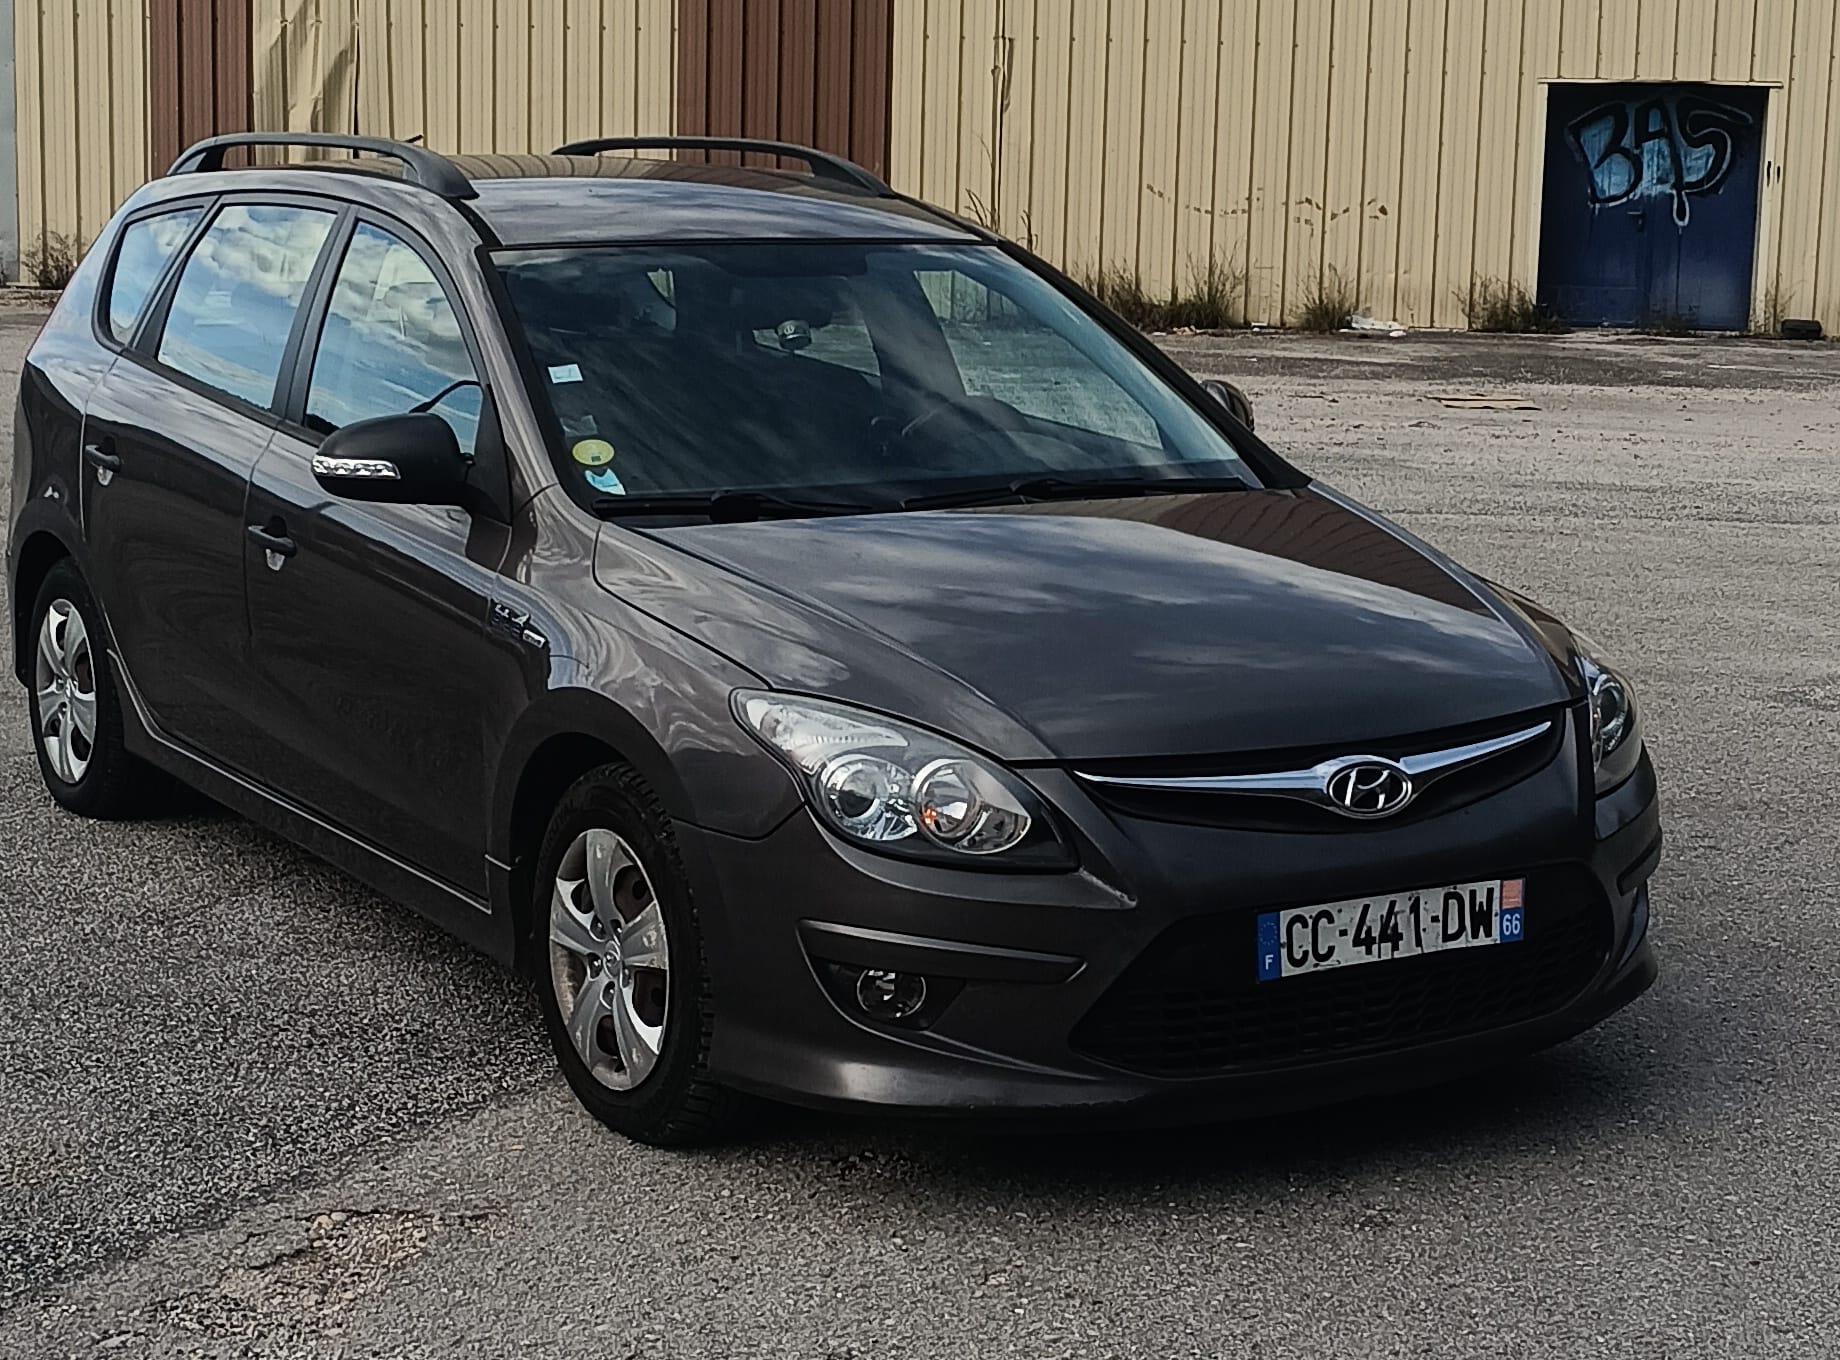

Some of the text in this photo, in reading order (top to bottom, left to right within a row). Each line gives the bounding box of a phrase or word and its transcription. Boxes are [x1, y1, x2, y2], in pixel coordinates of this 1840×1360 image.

[1265, 886, 1521, 970] F CC-441-DW 66
